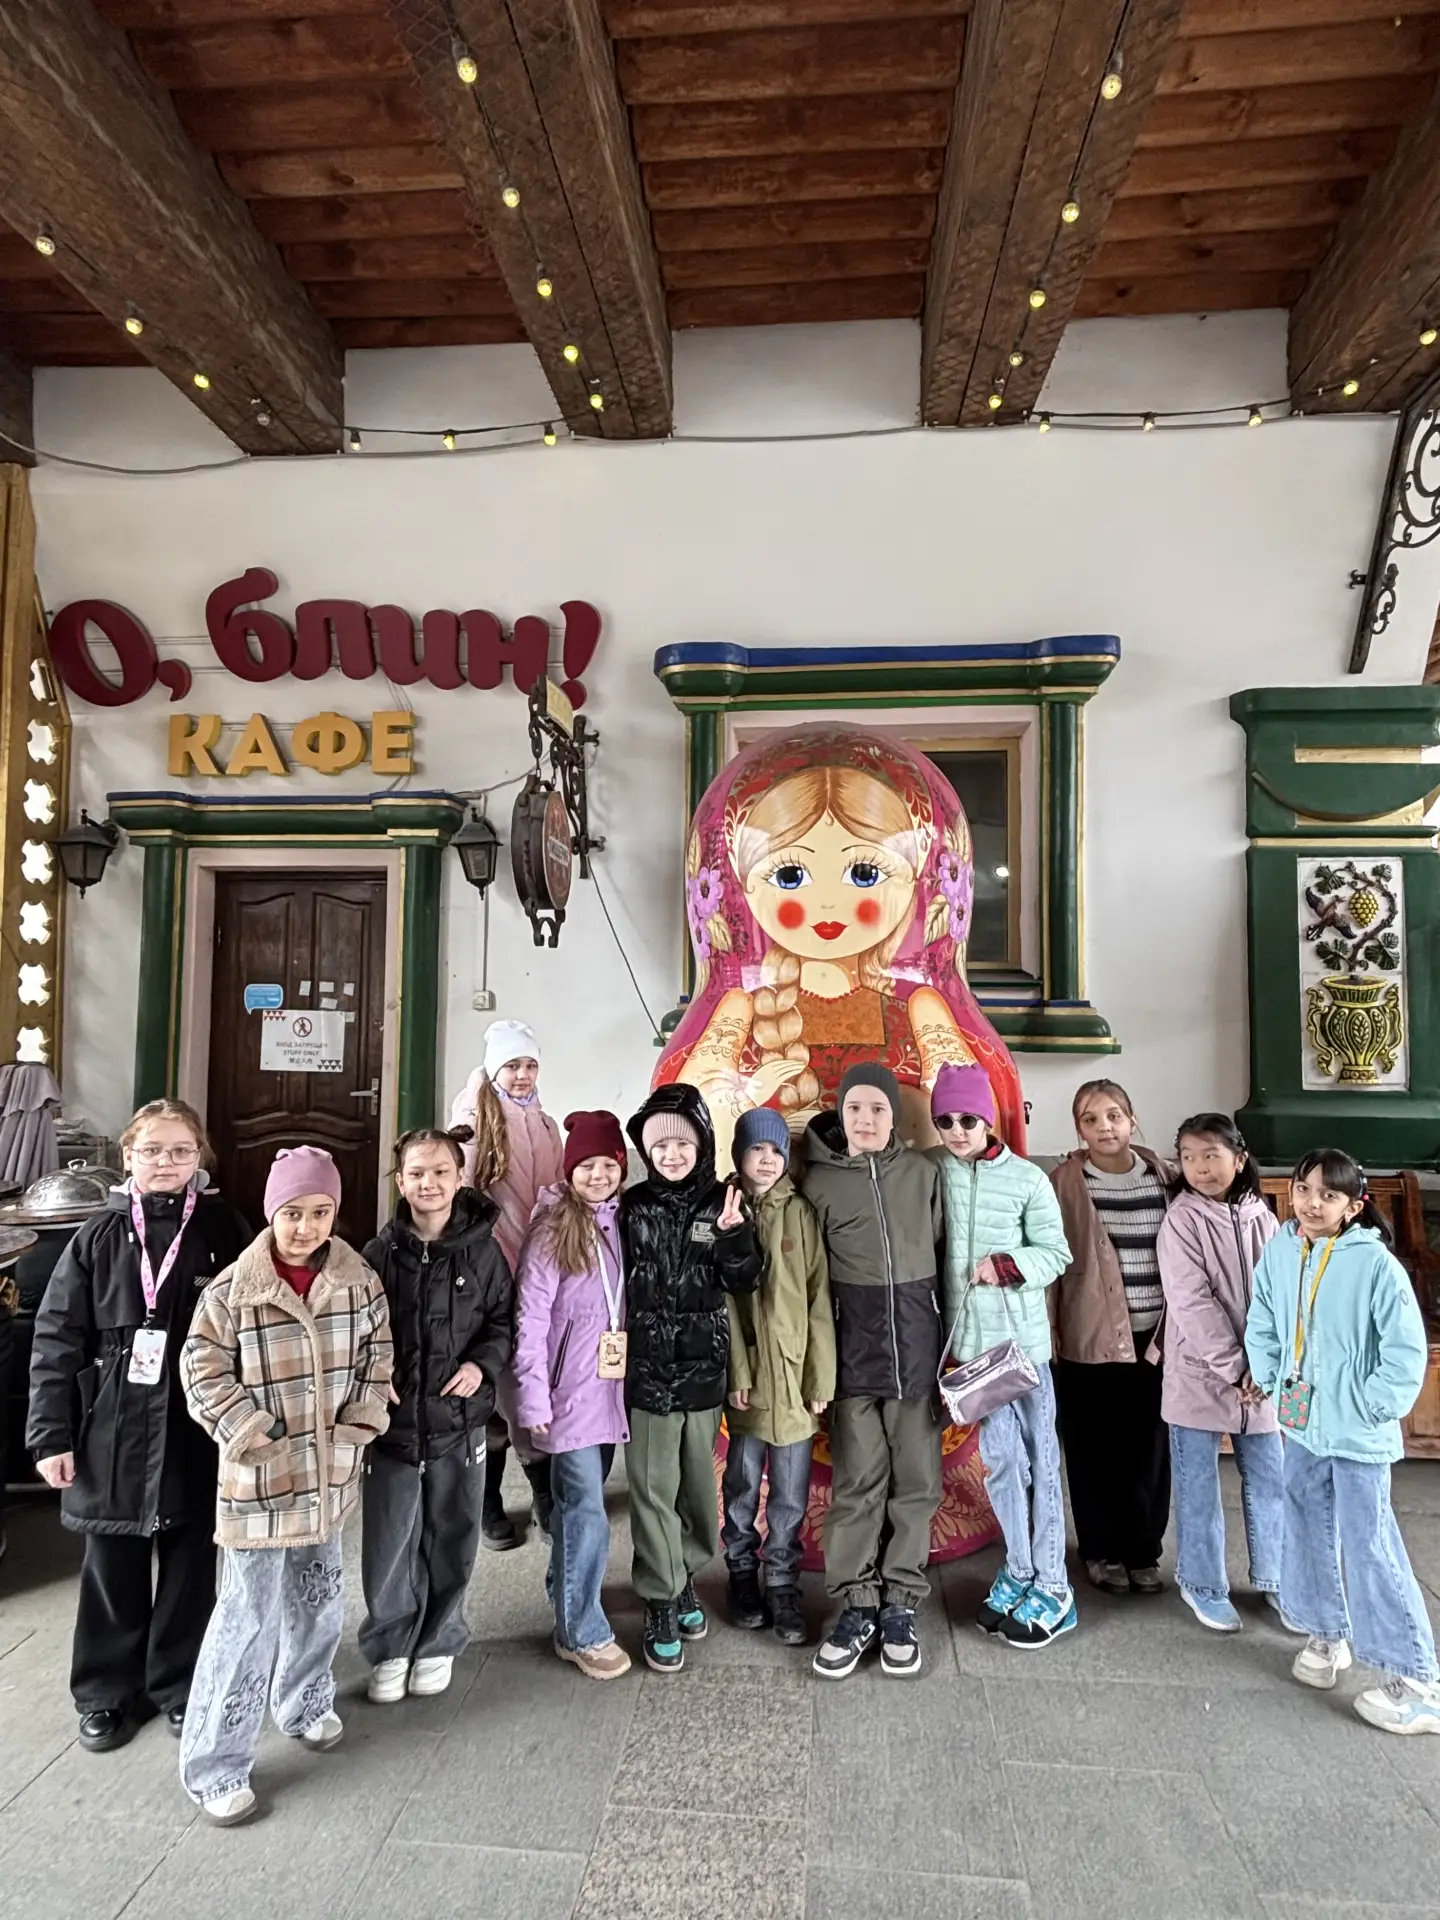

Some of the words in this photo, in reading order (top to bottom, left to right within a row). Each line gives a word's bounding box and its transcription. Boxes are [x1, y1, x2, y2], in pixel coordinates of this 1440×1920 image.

[48, 599, 192, 707] О,
[206, 566, 602, 711] блин!
[167, 711, 417, 778] КАФЕ
